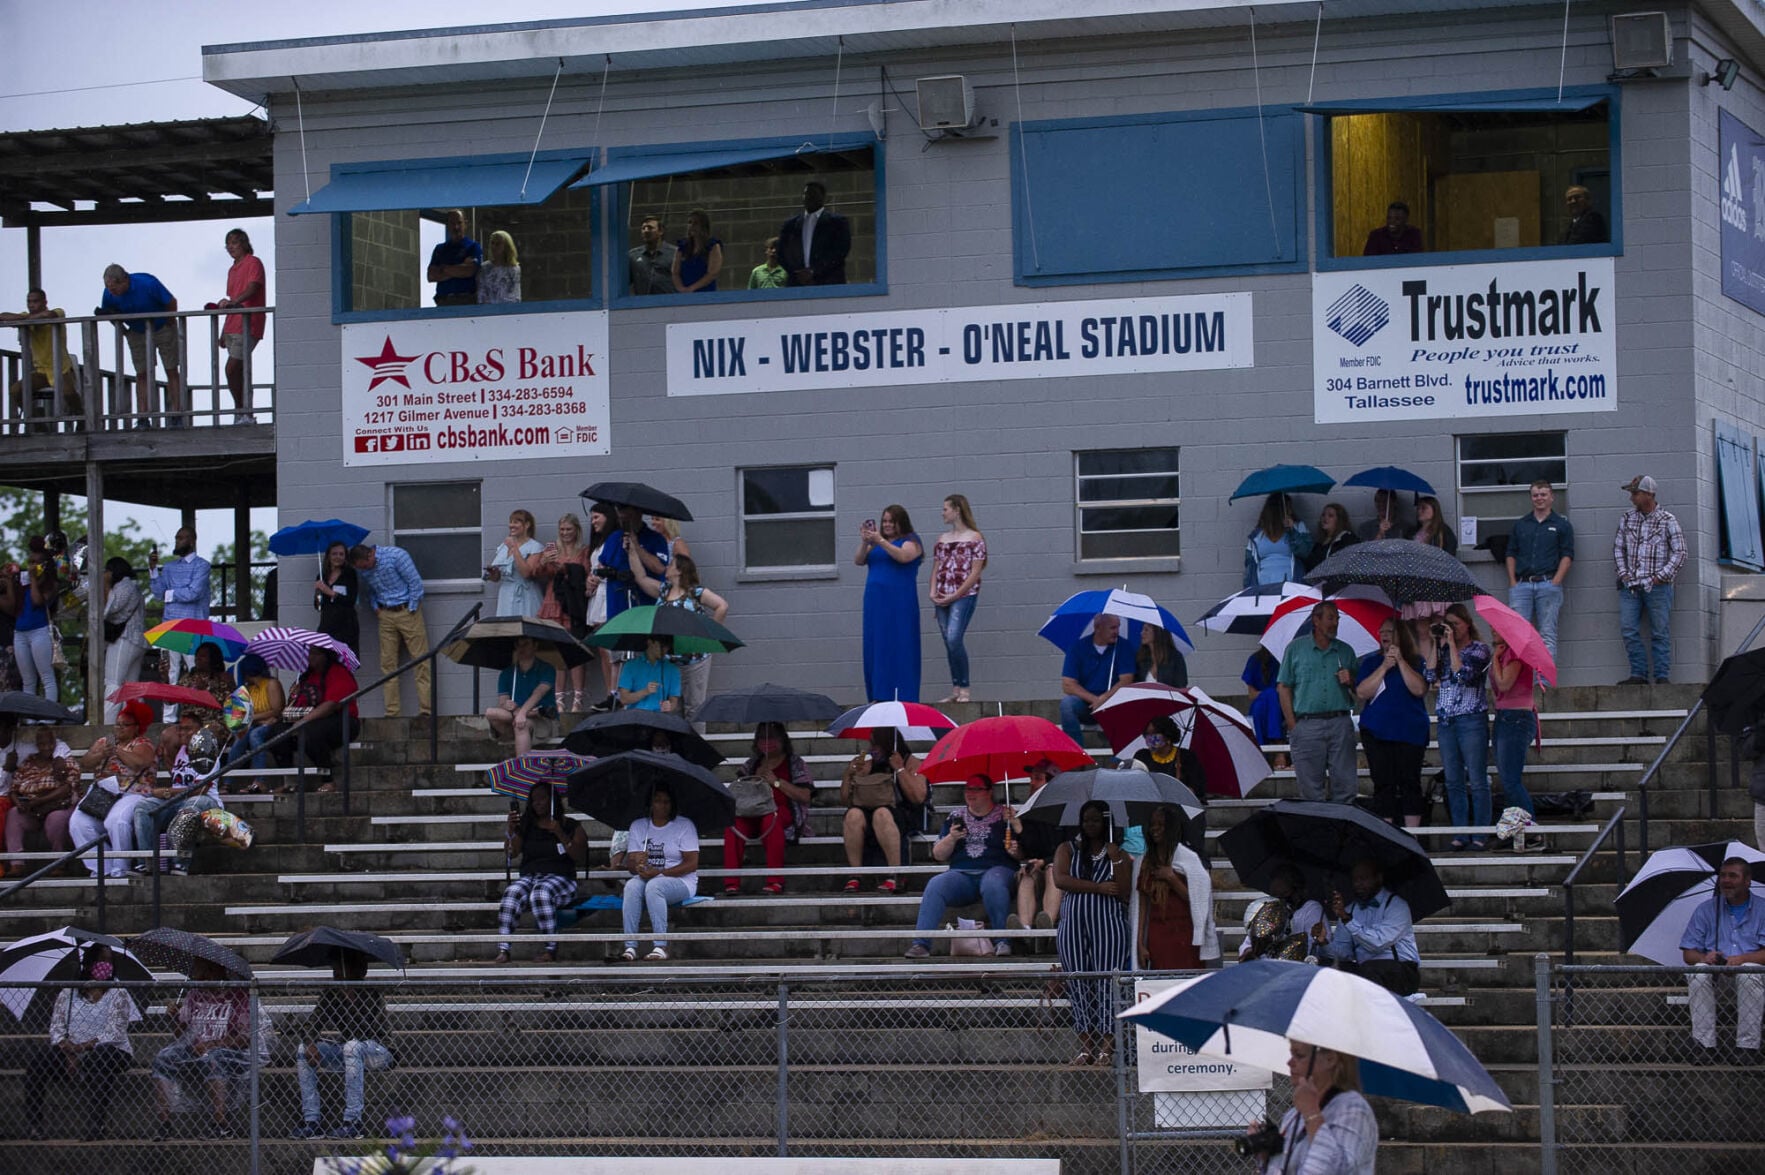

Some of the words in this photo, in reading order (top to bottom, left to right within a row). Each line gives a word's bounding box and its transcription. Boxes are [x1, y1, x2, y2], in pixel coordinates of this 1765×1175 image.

[1402, 271, 1602, 342] Trustmark
[692, 336, 747, 379] NIX
[781, 327, 926, 374] WEBSTER
[963, 319, 1070, 366] O'NEAL
[1080, 311, 1226, 359] STADIUM
[1410, 346, 1480, 364] People
[1483, 348, 1523, 363] you
[1530, 342, 1579, 356] trust
[424, 348, 505, 385] CB&S
[517, 344, 596, 381] Bank
[1340, 357, 1366, 368] Member
[1366, 355, 1382, 366] FDIC
[1496, 359, 1536, 368] Advice
[1538, 356, 1561, 365] that
[1564, 354, 1601, 364] works.
[1326, 377, 1353, 391] 304
[1356, 375, 1411, 390] Barnett
[1414, 373, 1453, 388] Blvd.
[1464, 368, 1606, 405] trustmark.com
[376, 394, 399, 408] 301
[403, 393, 433, 406] Main
[437, 391, 477, 405] Street
[488, 385, 574, 402] 334-283-6594
[1344, 395, 1435, 409] Tallassee
[364, 411, 394, 424] 1217
[398, 410, 440, 423] Gilmer
[443, 407, 490, 421] Avenue
[500, 400, 587, 418] 334-283-8368
[355, 427, 392, 435] Connect
[393, 425, 415, 433] With
[417, 424, 429, 432] Us
[436, 422, 550, 449] cbsbank.com
[576, 432, 598, 443] FDIC
[1167, 1064, 1237, 1075] ceremony.
